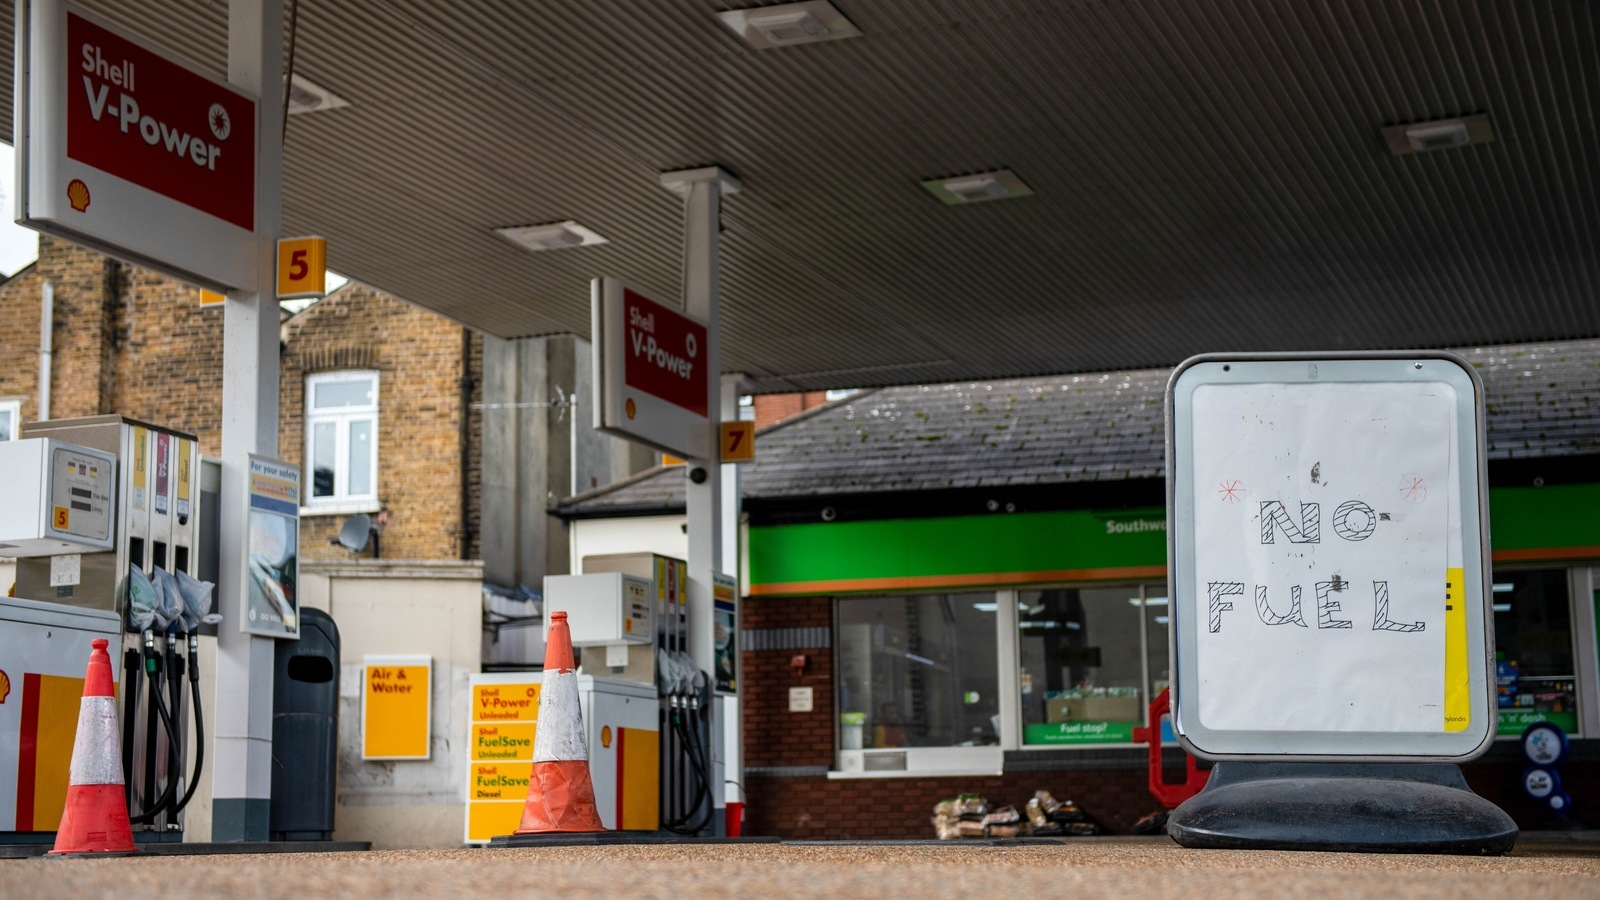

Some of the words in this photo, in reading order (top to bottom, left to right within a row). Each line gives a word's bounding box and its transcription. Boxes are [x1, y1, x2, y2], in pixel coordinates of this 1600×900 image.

[81, 43, 135, 92] Shell
[82, 75, 221, 171] V-Power
[288, 249, 309, 281] 5
[629, 305, 655, 333] Shell
[630, 328, 692, 379] V-Power
[729, 430, 745, 452] 7
[251, 460, 262, 470] For
[263, 465, 278, 475] your
[279, 469, 298, 481] safety
[58, 511, 66, 526] 5
[1259, 499, 1378, 545] NO
[1206, 580, 1427, 634] FUEL
[372, 669, 392, 680] Air
[397, 669, 407, 679] &
[372, 683, 413, 694] Water
[480, 689, 499, 697] Shell
[481, 698, 531, 708] V-Power
[479, 711, 519, 719] Unleaded
[479, 728, 498, 736] Shell
[1060, 723, 1081, 734] Fuel
[478, 736, 530, 747] FuelSave
[478, 750, 517, 758] Unleaded
[478, 767, 497, 775] Shell
[477, 775, 529, 787] FuelSave
[477, 790, 501, 798] Diesel
